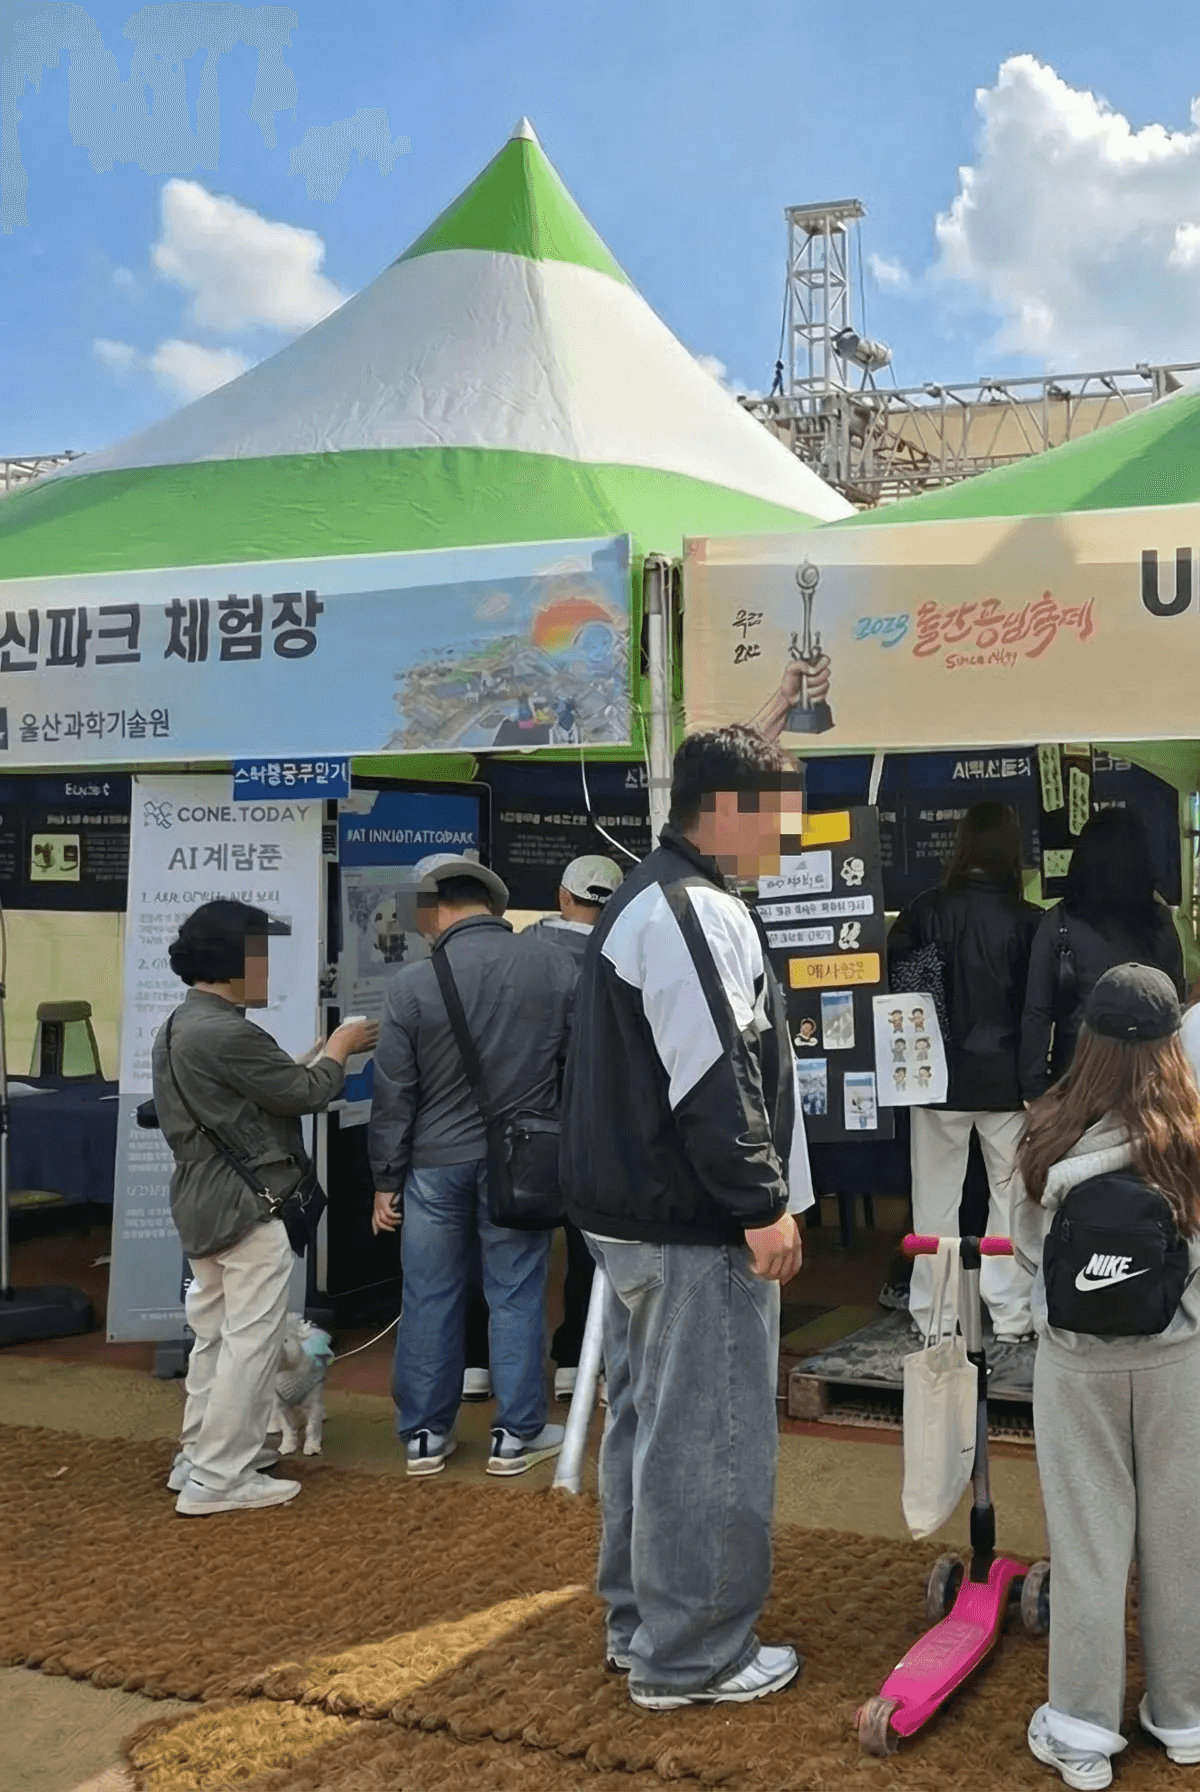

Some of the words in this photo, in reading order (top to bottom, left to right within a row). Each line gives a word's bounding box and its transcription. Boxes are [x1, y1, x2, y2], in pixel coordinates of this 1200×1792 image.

[0, 603, 141, 672] 신파크
[164, 589, 324, 663] 체험장
[19, 708, 170, 742] 울산과학기술원
[178, 806, 310, 823] CONE.TODAY
[1085, 1252, 1132, 1278] NIKE
